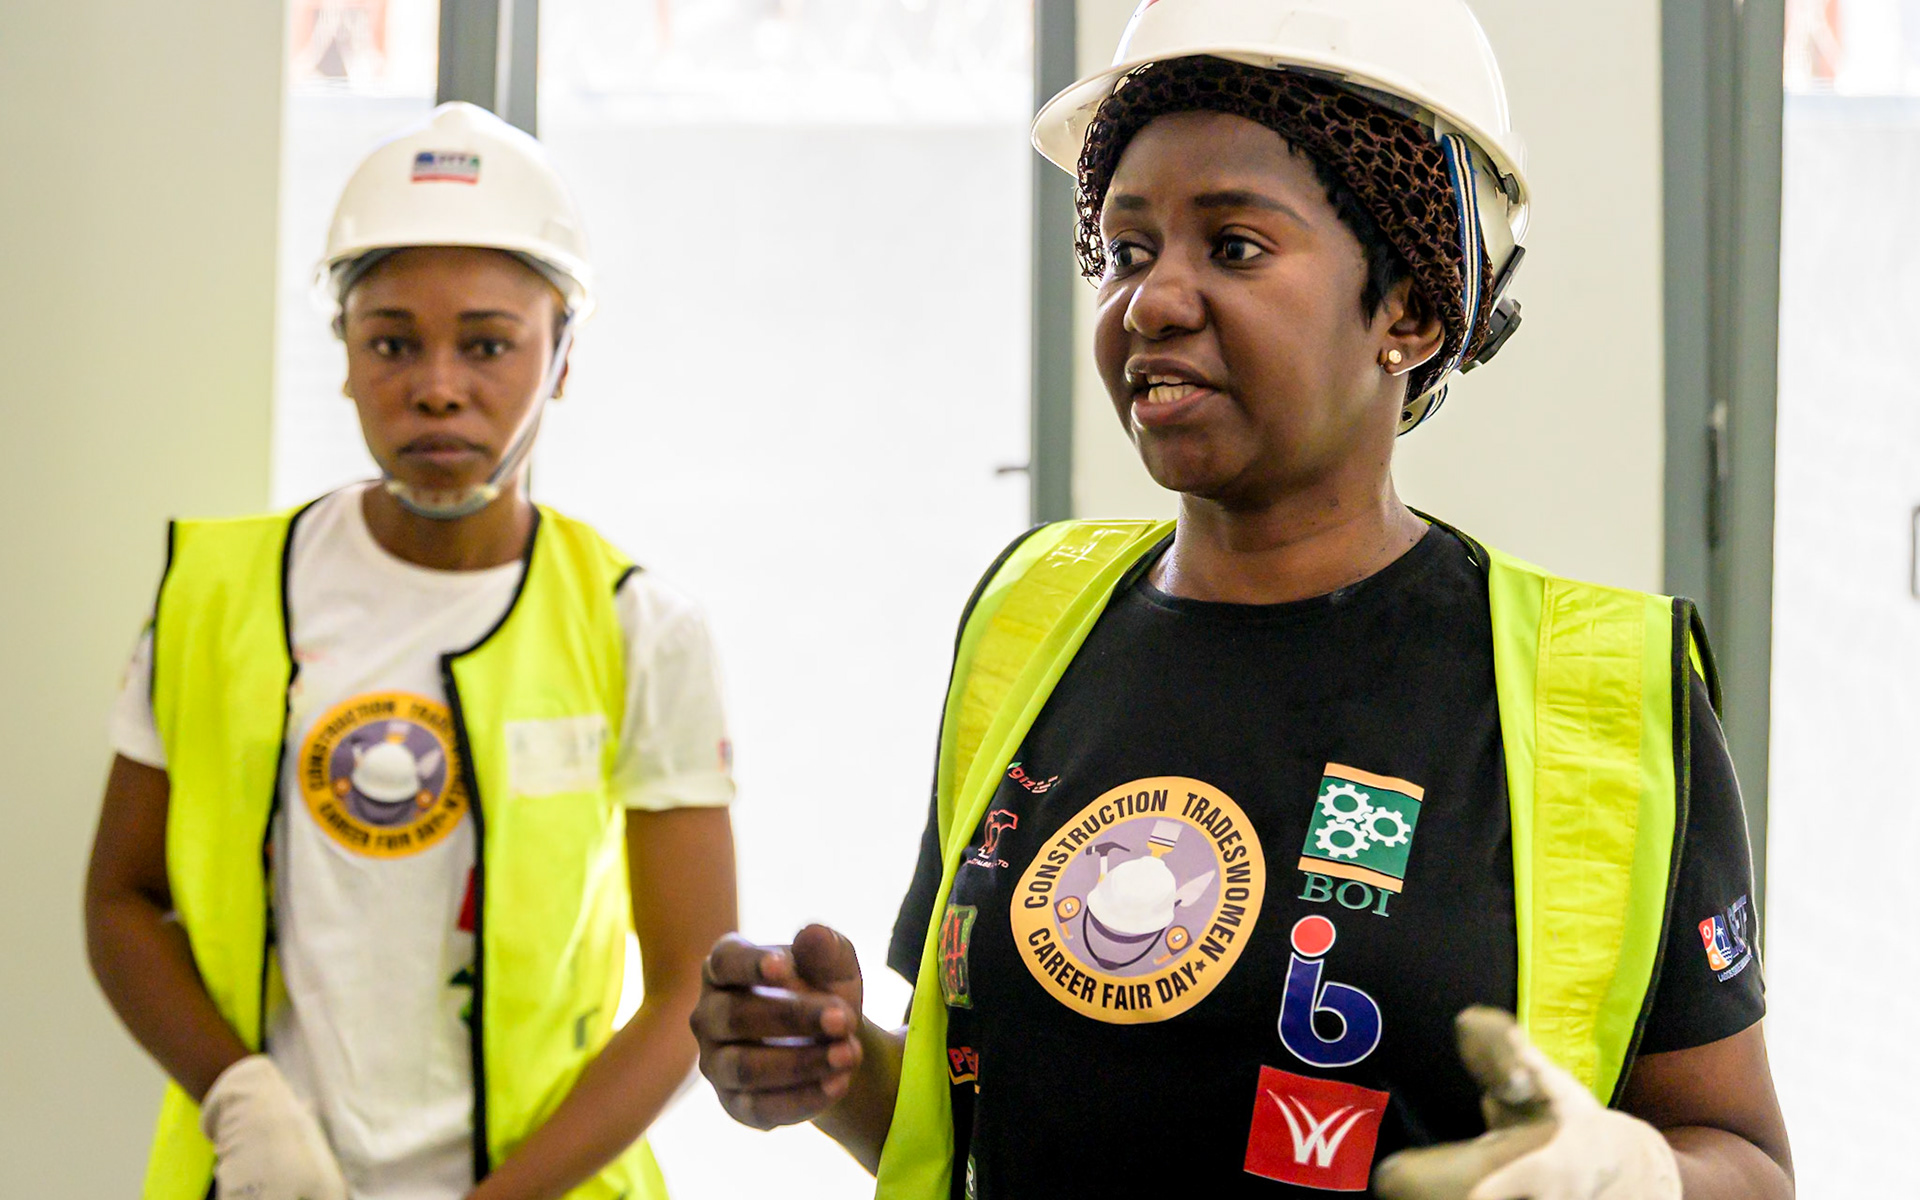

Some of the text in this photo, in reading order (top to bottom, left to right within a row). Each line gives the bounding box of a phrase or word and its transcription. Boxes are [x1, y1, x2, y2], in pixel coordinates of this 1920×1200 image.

[1024, 789, 1251, 962] CONSTRUCTION TRADESWOMEN
[1297, 872, 1394, 917] BOI
[1028, 927, 1098, 1004] CAREER
[1102, 983, 1153, 1011] FAIR
[1155, 961, 1199, 1004] DAY
